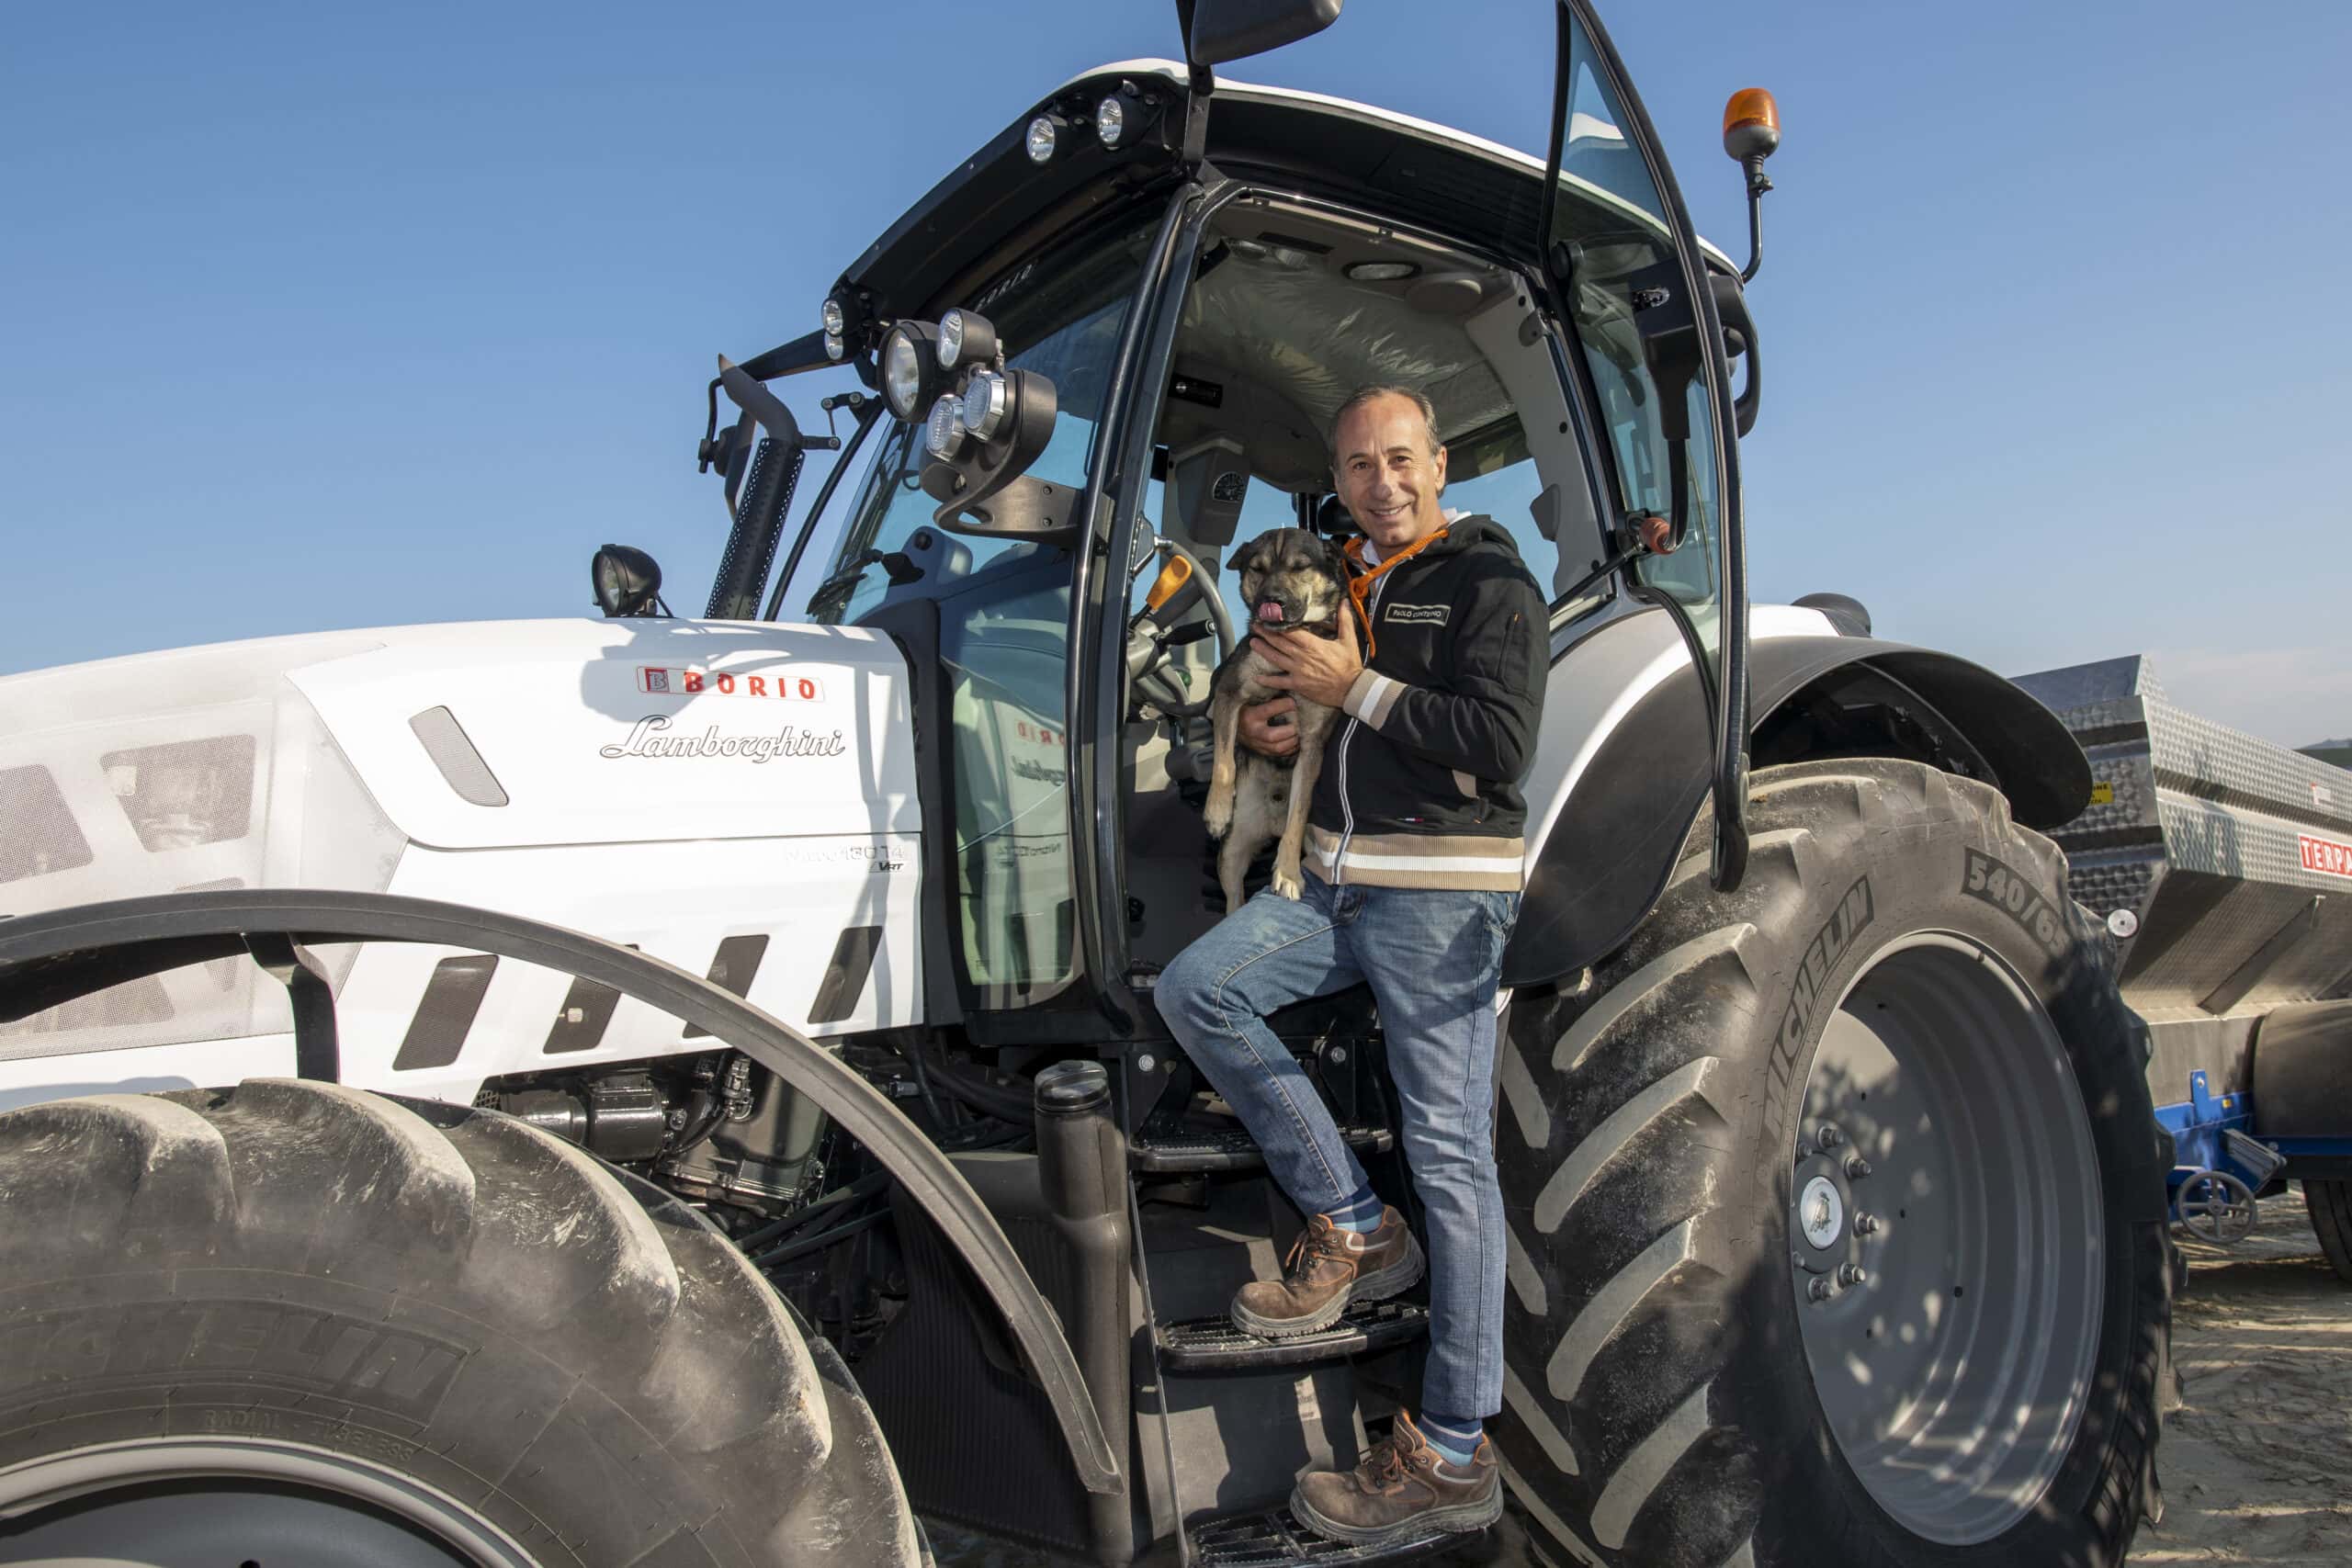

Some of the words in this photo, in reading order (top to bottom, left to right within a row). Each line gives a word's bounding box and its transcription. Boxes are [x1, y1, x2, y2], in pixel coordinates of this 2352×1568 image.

[682, 670, 816, 700] BORIO
[600, 714, 846, 764] Lamborghini
[1763, 878, 1871, 1145] MICHELIN
